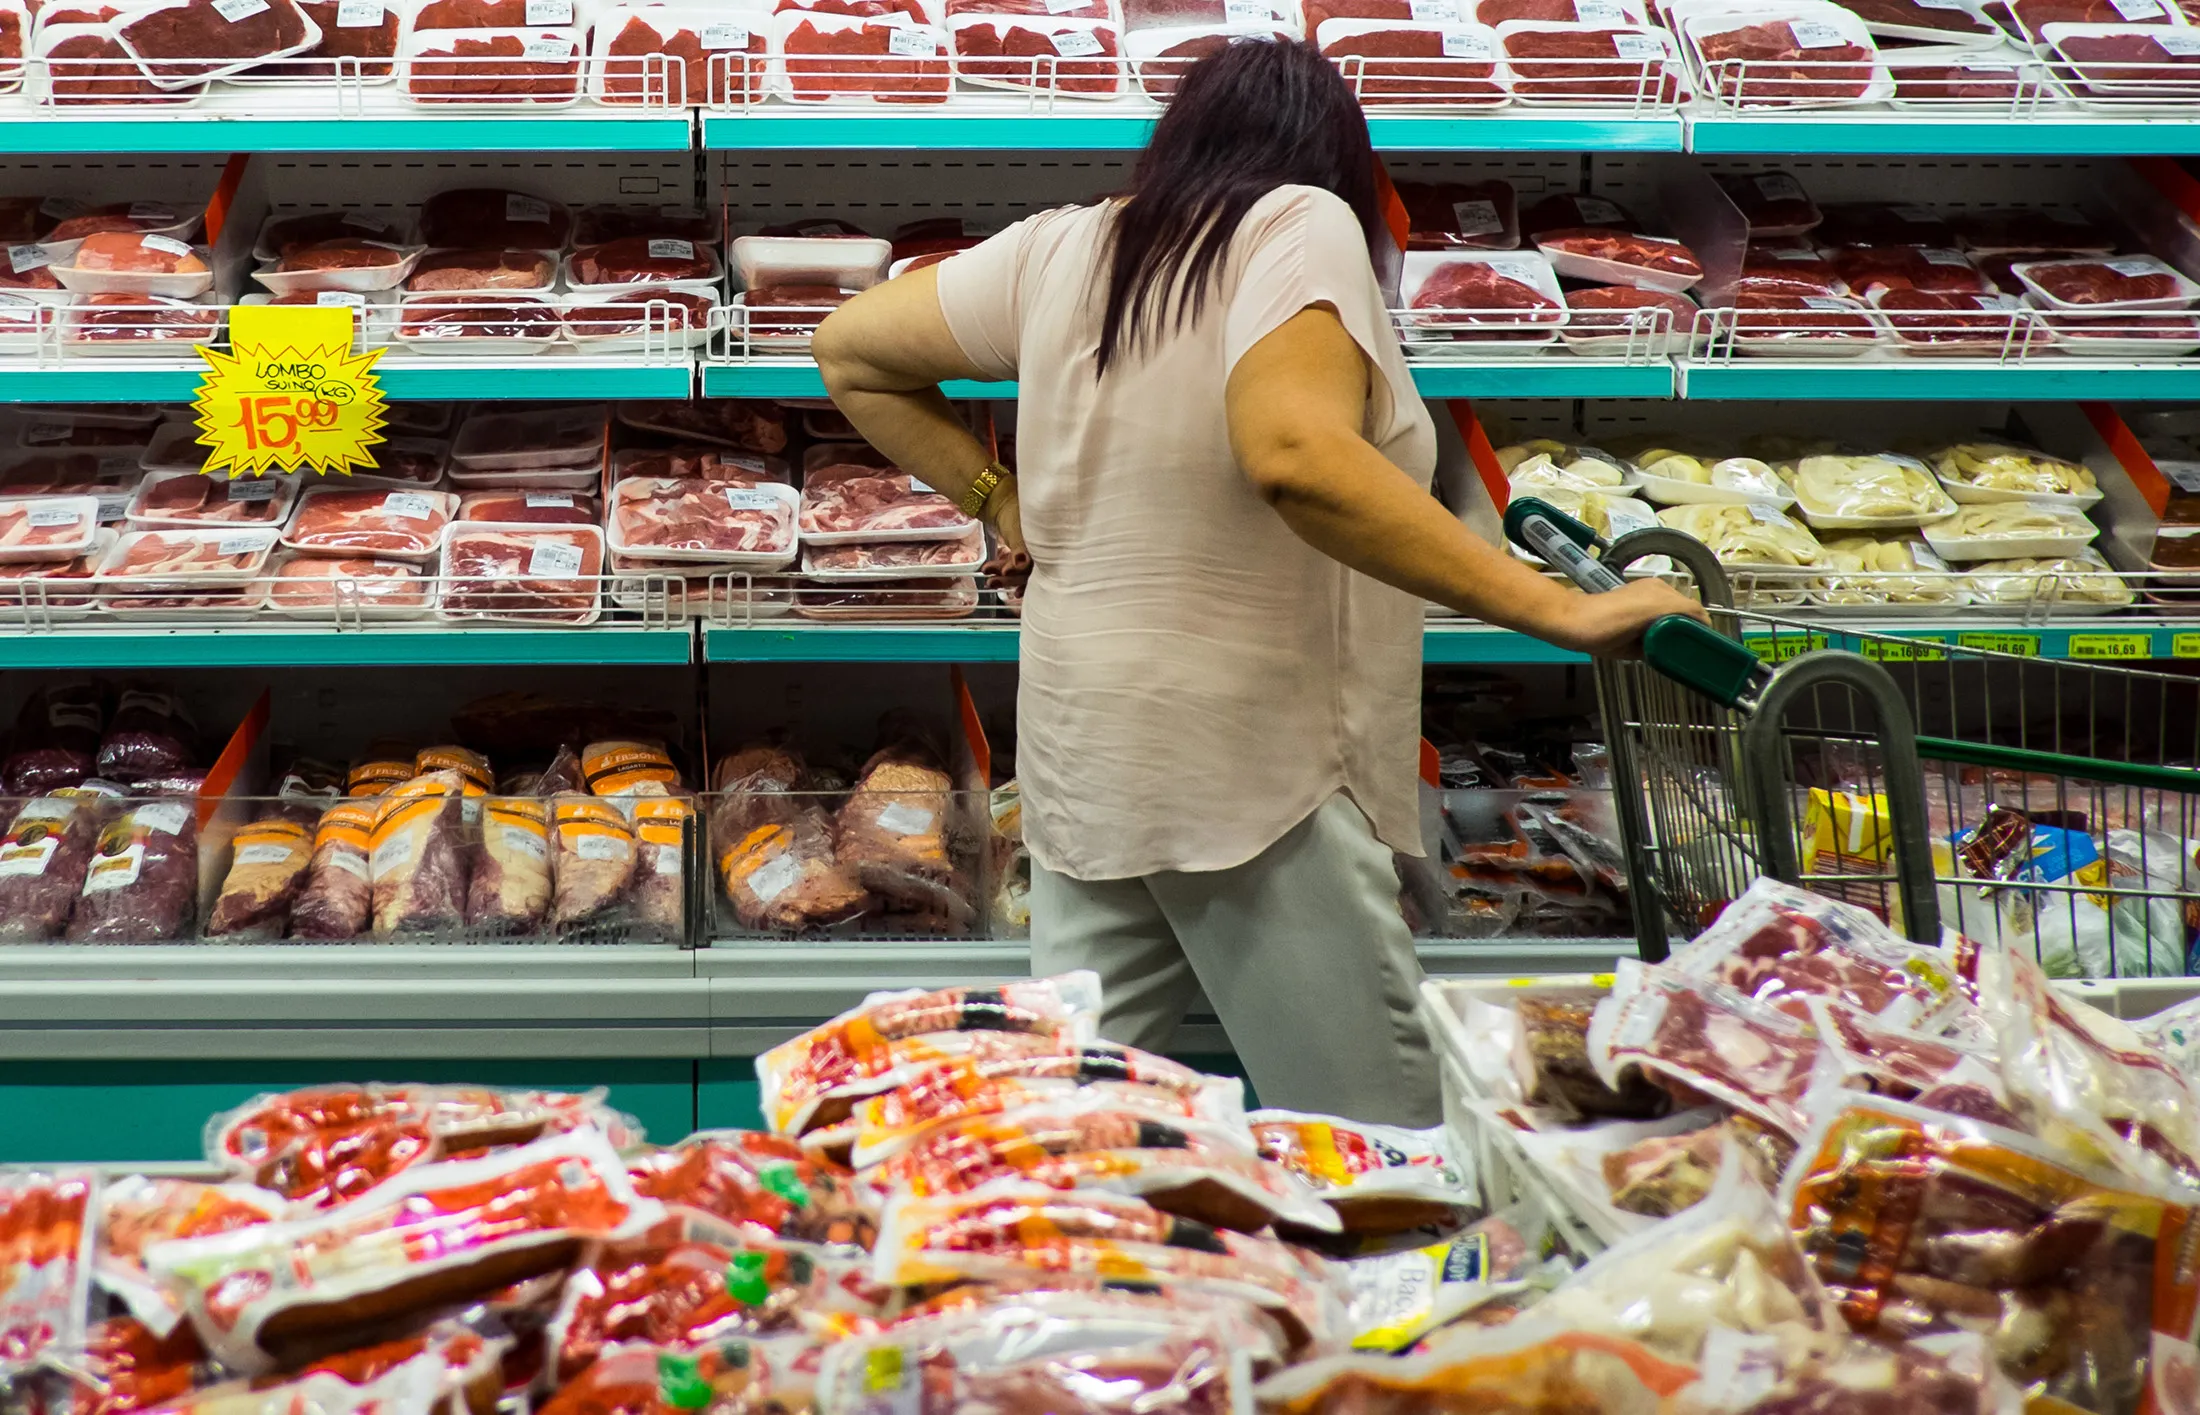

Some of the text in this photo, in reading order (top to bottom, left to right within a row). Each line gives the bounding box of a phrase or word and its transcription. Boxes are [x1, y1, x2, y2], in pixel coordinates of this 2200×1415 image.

[255, 361, 326, 380] LOMBO
[264, 379, 348, 399] SUINO KG
[228, 396, 339, 455] 15,99
[1900, 646, 1930, 657] 1669
[2107, 643, 2136, 656] 16,69
